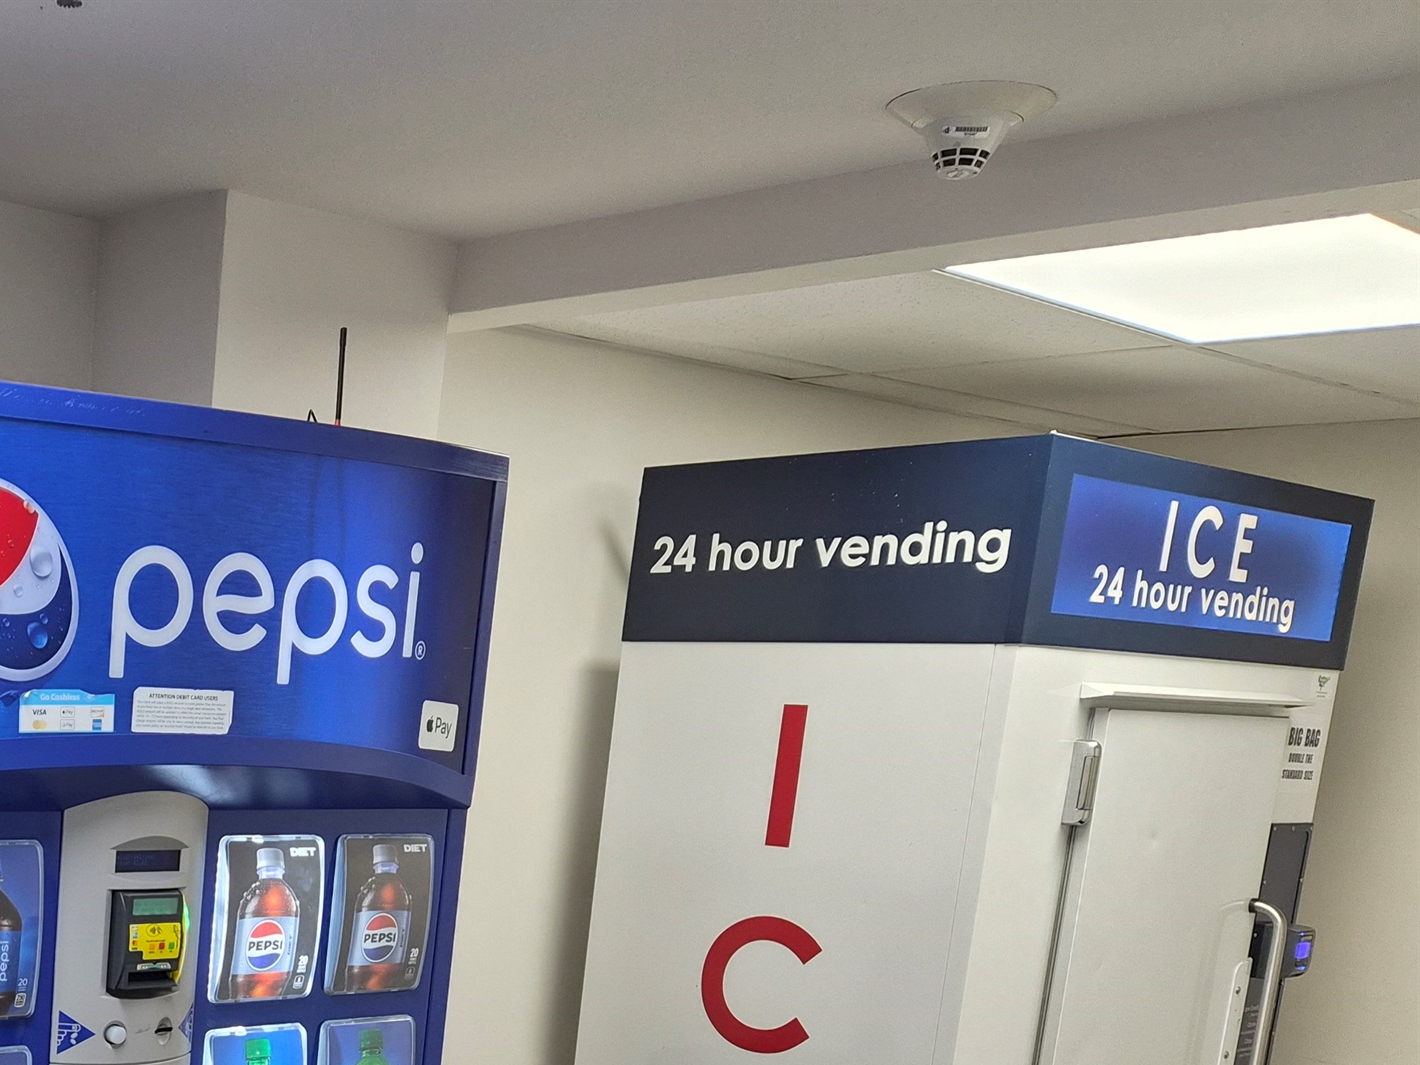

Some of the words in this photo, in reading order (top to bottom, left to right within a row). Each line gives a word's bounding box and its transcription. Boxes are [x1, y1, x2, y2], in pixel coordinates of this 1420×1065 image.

[650, 535, 697, 573] 24
[708, 534, 801, 572] hour
[817, 521, 1013, 574] vending
[1159, 500, 1258, 585] ICE
[1089, 565, 1123, 605] 24
[1132, 571, 1192, 614] hour
[1199, 584, 1296, 634] vending
[108, 542, 426, 685] pepsi
[50, 693, 80, 701] Cashless
[435, 718, 452, 739] Pay
[1288, 727, 1304, 746] BIG
[1304, 728, 1321, 747] BAG
[1288, 753, 1304, 763] DOUBLE
[1305, 754, 1313, 764] THE
[1282, 769, 1303, 779] STANDARD
[1304, 770, 1314, 780] SIZE
[290, 847, 316, 857] DIET
[404, 844, 428, 853] DIET
[363, 933, 396, 943] PEPSI
[248, 940, 283, 951] PEPSI
[410, 948, 419, 957] 20
[0, 940, 10, 982] pepsi
[299, 955, 308, 966] 20
[18, 978, 28, 987] 20
